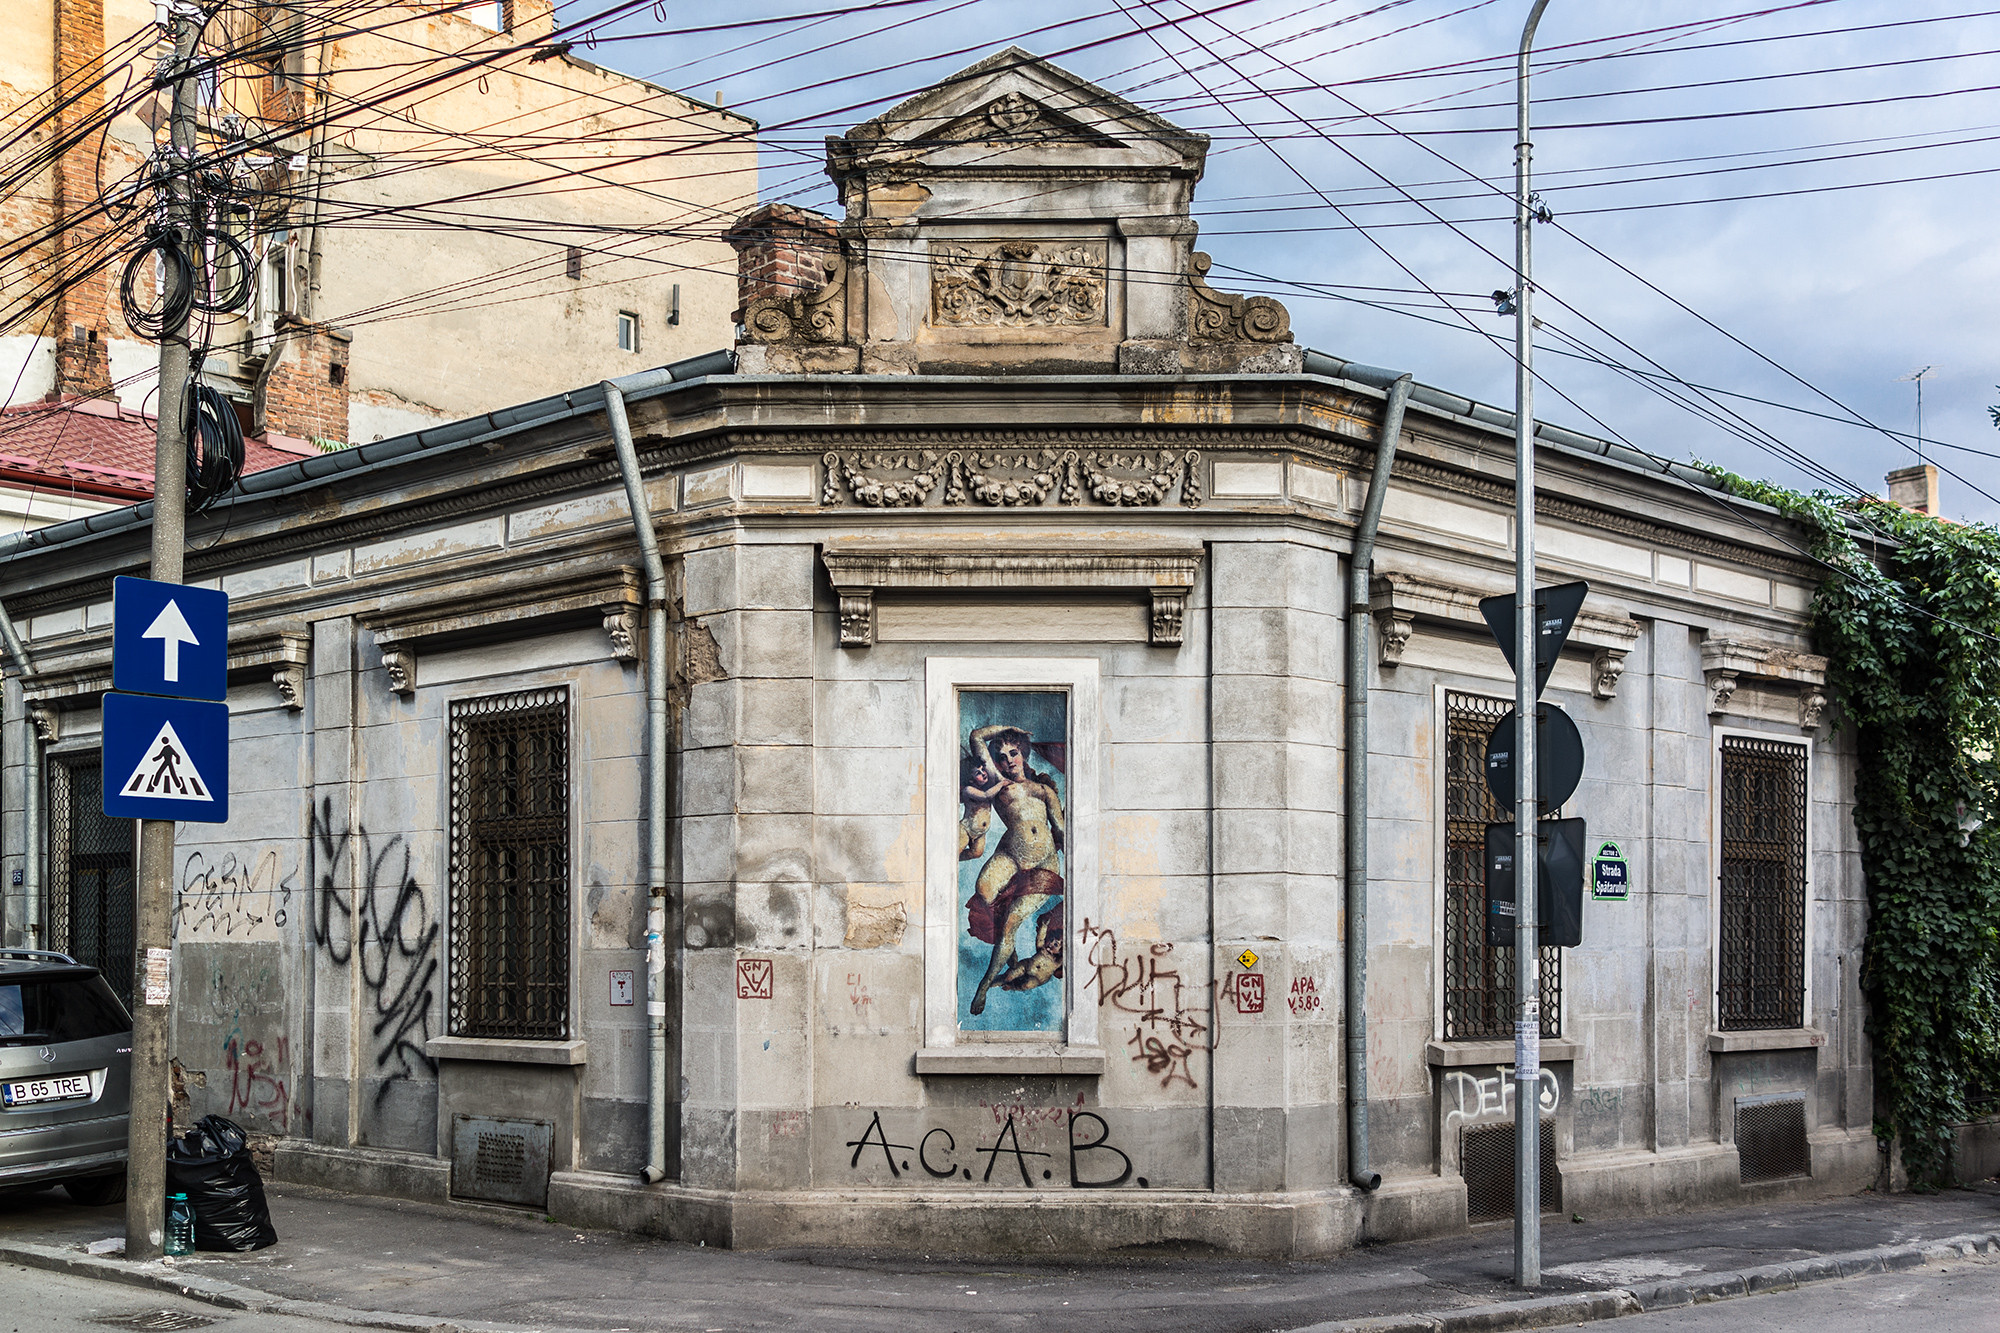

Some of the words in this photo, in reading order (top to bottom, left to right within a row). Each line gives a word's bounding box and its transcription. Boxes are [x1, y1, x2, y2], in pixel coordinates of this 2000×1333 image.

[1602, 863, 1621, 877] Strada
[1596, 881, 1627, 895] Spătarului
[1240, 976, 1261, 988] GN
[14, 1084, 26, 1099] B
[30, 1081, 49, 1097] 65
[53, 1078, 84, 1095] TRE
[846, 1111, 1150, 1188] A.C.A.B.
